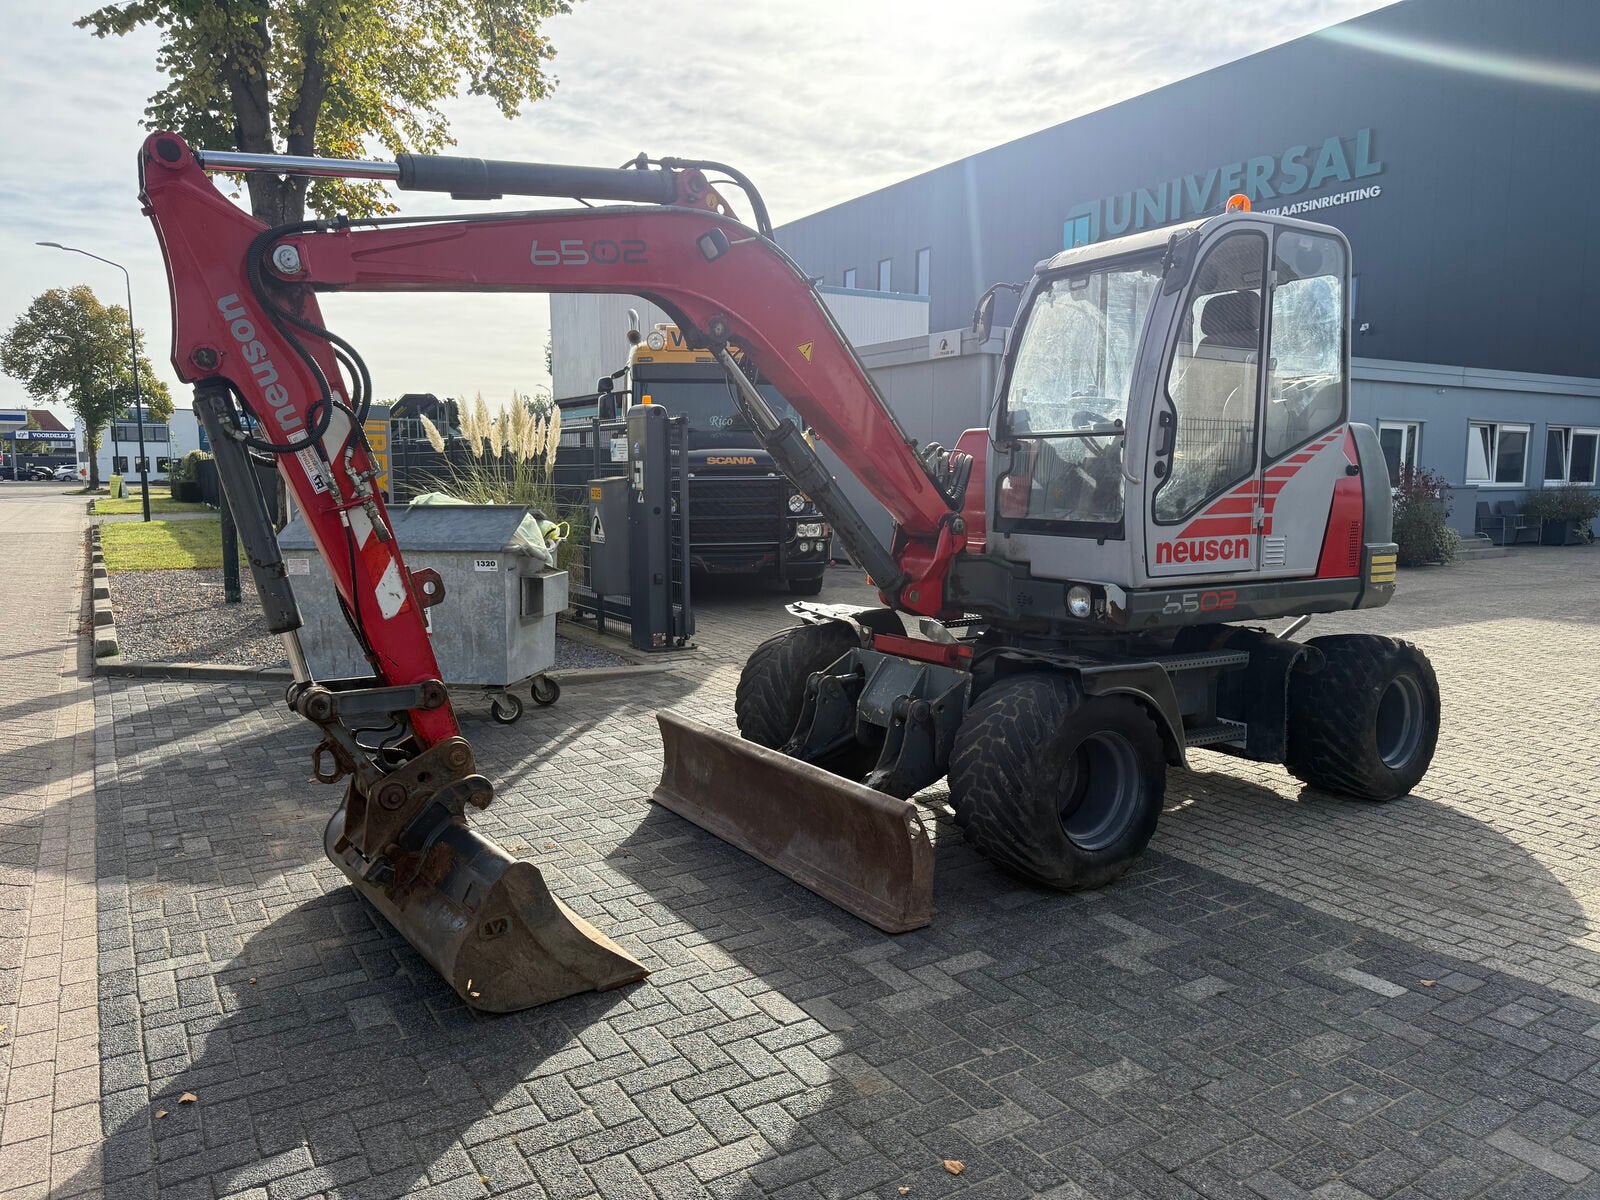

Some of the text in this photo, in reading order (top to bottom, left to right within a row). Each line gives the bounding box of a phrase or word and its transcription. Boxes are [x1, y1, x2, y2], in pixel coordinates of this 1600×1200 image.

[1104, 127, 1382, 235] UNIVERSAL
[1262, 185, 1382, 217] PLAATSINRICHTING
[530, 239, 649, 266] 6502
[217, 294, 303, 431] neuson
[709, 415, 733, 428] Rico
[706, 456, 757, 465] SCANIA
[1156, 537, 1250, 564] neuson
[1162, 590, 1237, 614] 6502
